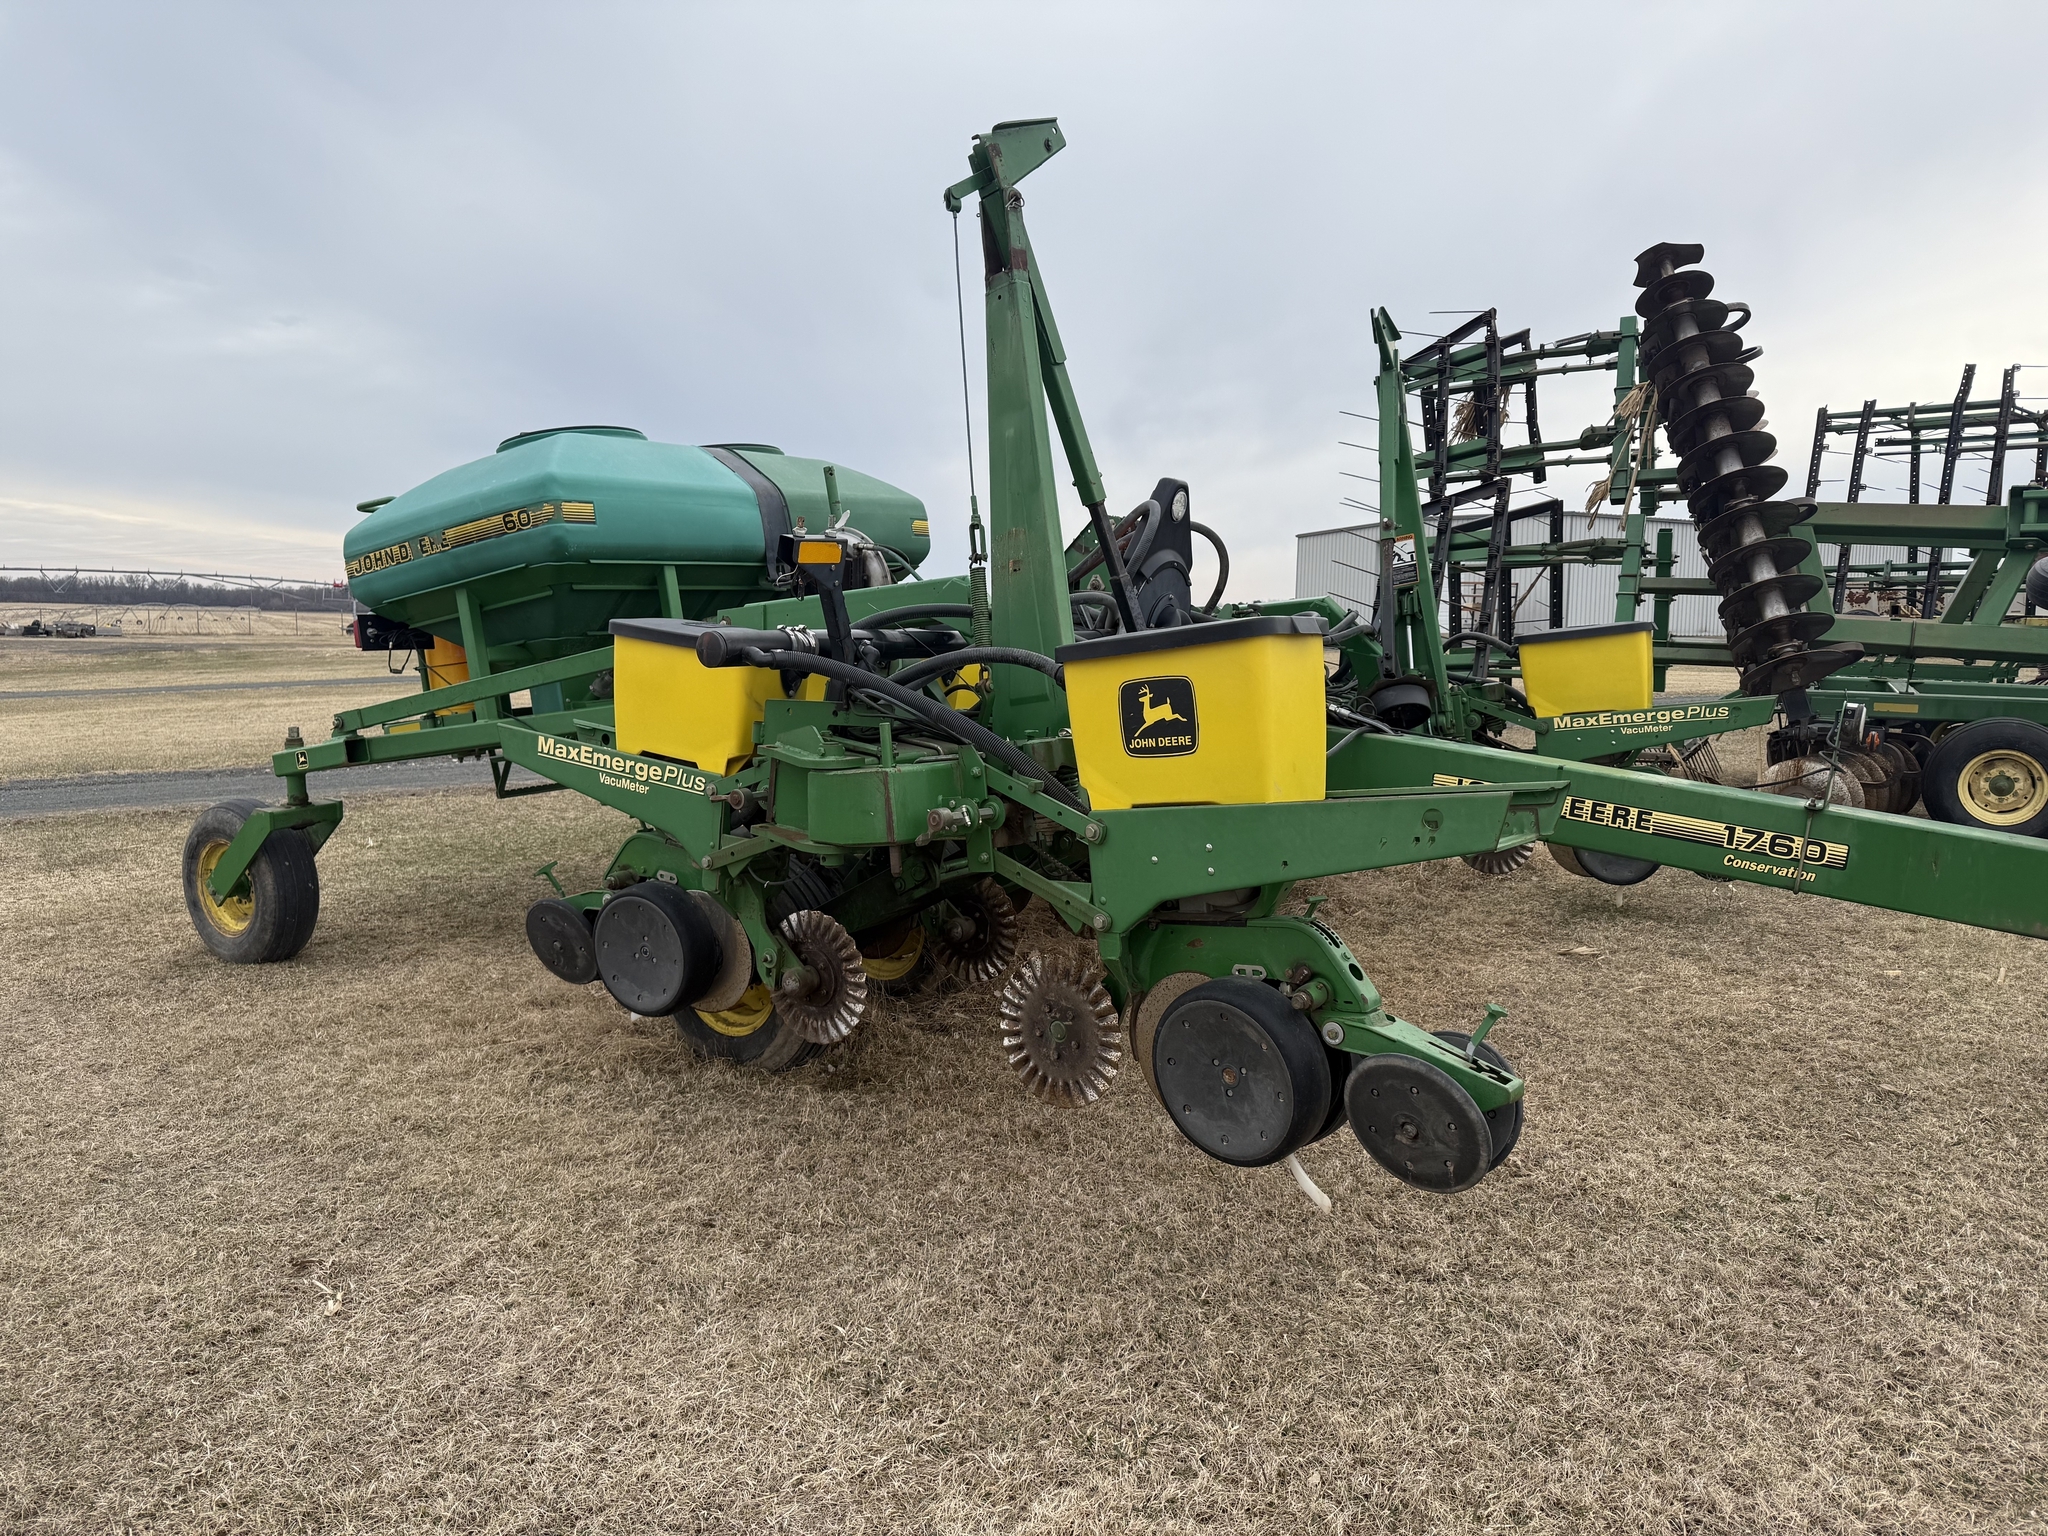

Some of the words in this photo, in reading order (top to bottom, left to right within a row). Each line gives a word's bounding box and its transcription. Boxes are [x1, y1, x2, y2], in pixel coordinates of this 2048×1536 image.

[354, 546, 397, 576] JOHN
[502, 508, 532, 533] 60
[1129, 737, 1156, 749] JOHN
[1157, 735, 1192, 747] DEERE
[1620, 724, 1674, 735] VacuMeter
[598, 772, 650, 795] VacuMeter
[1567, 797, 1653, 832] EERE
[1723, 825, 1828, 864] 1760
[1723, 854, 1817, 883] Conservation
